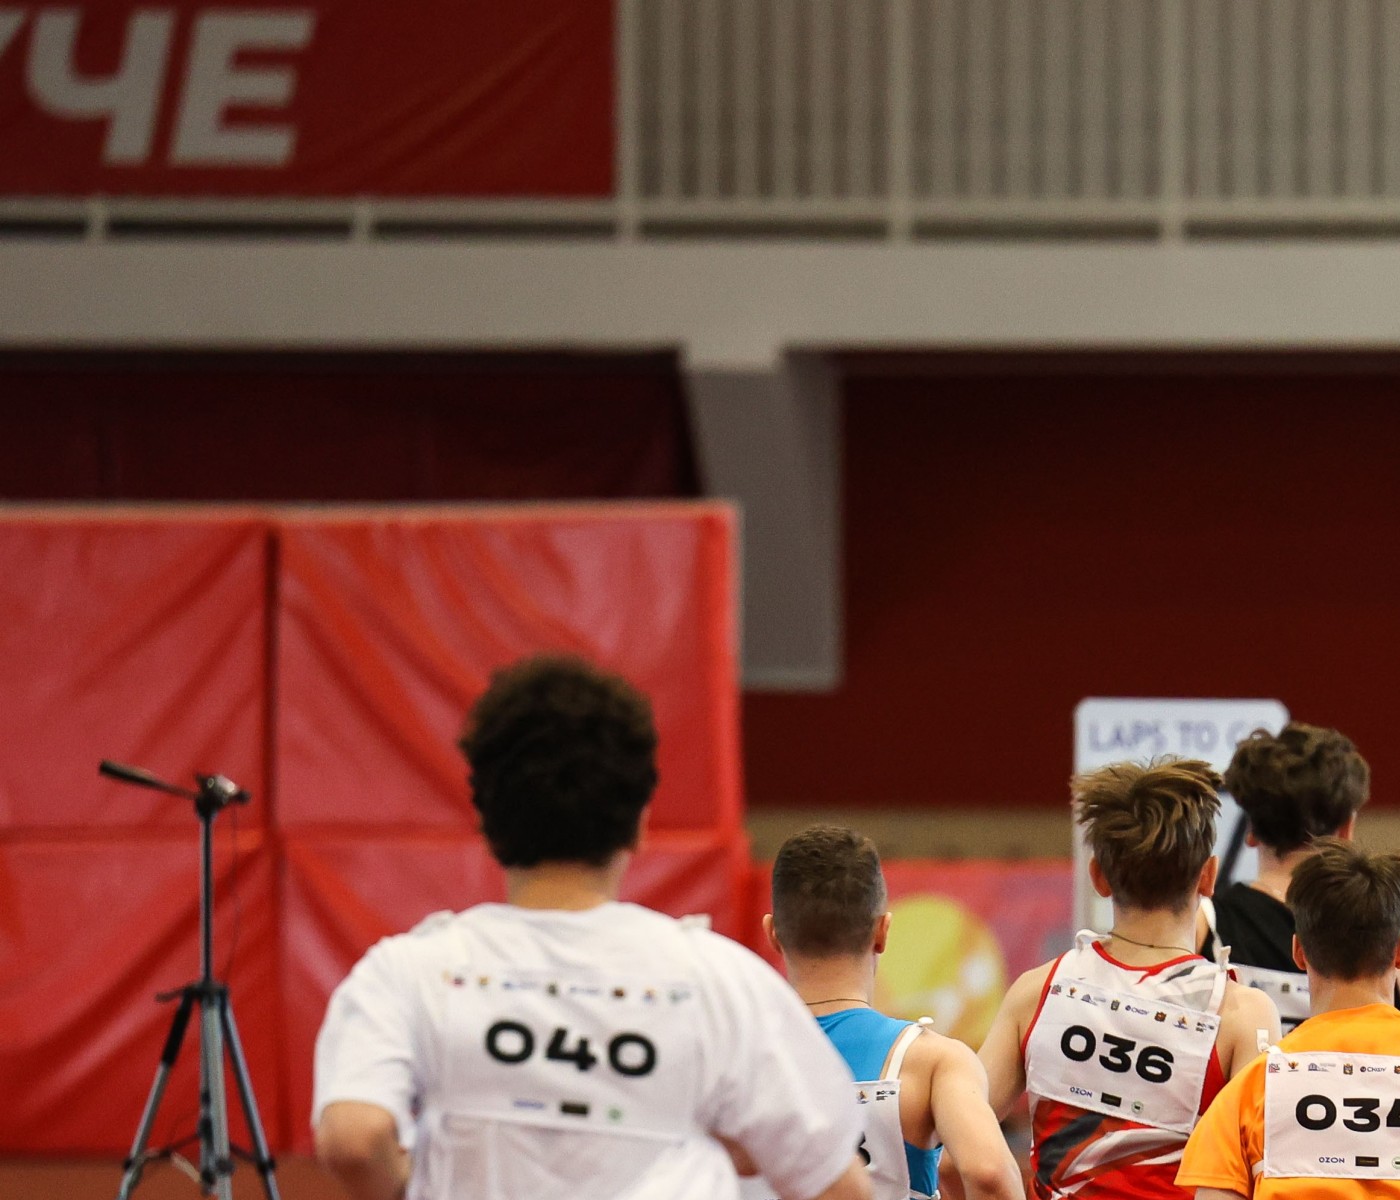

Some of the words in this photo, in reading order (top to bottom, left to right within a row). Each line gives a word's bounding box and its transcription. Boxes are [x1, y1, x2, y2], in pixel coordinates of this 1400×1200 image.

[1089, 719, 1169, 753] LAPS
[1180, 719, 1220, 753] TO
[485, 1020, 657, 1078] 040
[1060, 1025, 1175, 1083] 036
[1069, 1086, 1093, 1098] OZON
[1318, 1156, 1345, 1164] OZON
